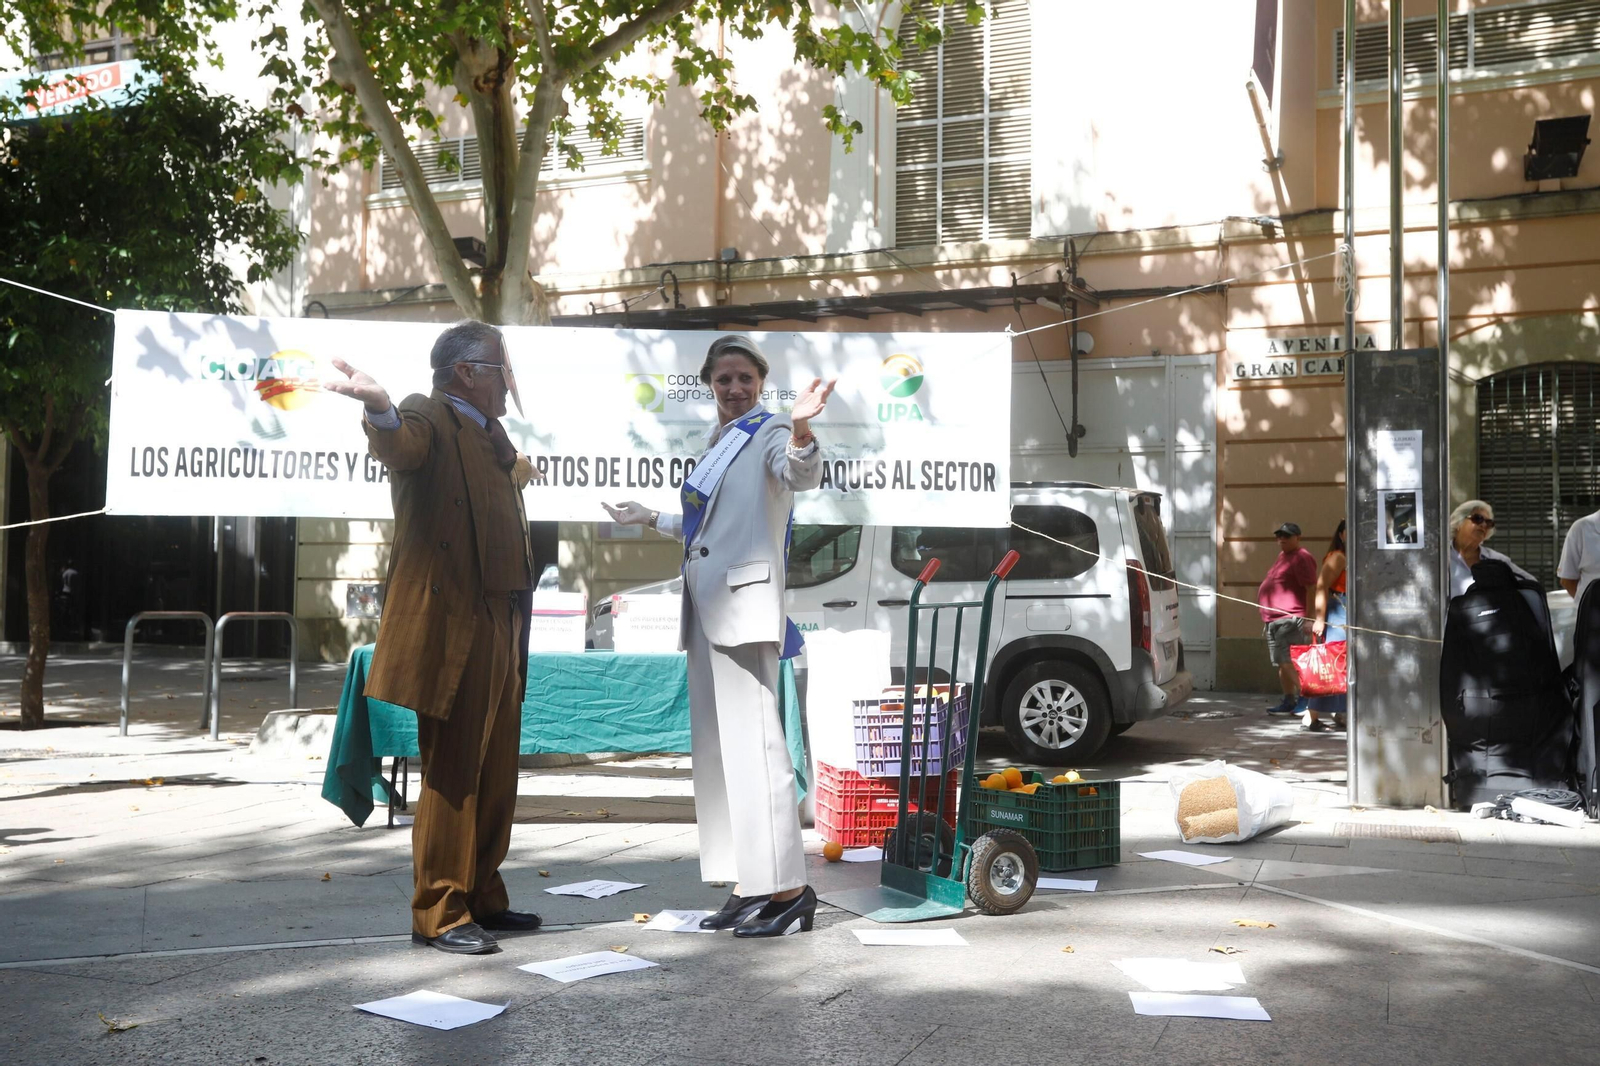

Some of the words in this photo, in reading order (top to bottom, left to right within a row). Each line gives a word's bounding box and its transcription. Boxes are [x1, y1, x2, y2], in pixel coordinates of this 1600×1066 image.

[1236, 362, 1295, 378] GRAN
[877, 403, 924, 422] UPA
[697, 467, 713, 489] URSULA
[710, 456, 722, 468] VON
[719, 446, 729, 457] DER
[728, 431, 742, 447] LEYEN
[130, 447, 169, 477] LOS
[174, 447, 339, 481] AGRICULTORES
[346, 452, 358, 482] Y
[595, 457, 620, 487] DE
[627, 457, 664, 488] LOS
[820, 460, 887, 492] AQUES
[892, 460, 916, 490] AL
[921, 460, 996, 492] SECTOR
[795, 623, 819, 631] SAJA
[991, 809, 1024, 822] SUNAMAR
